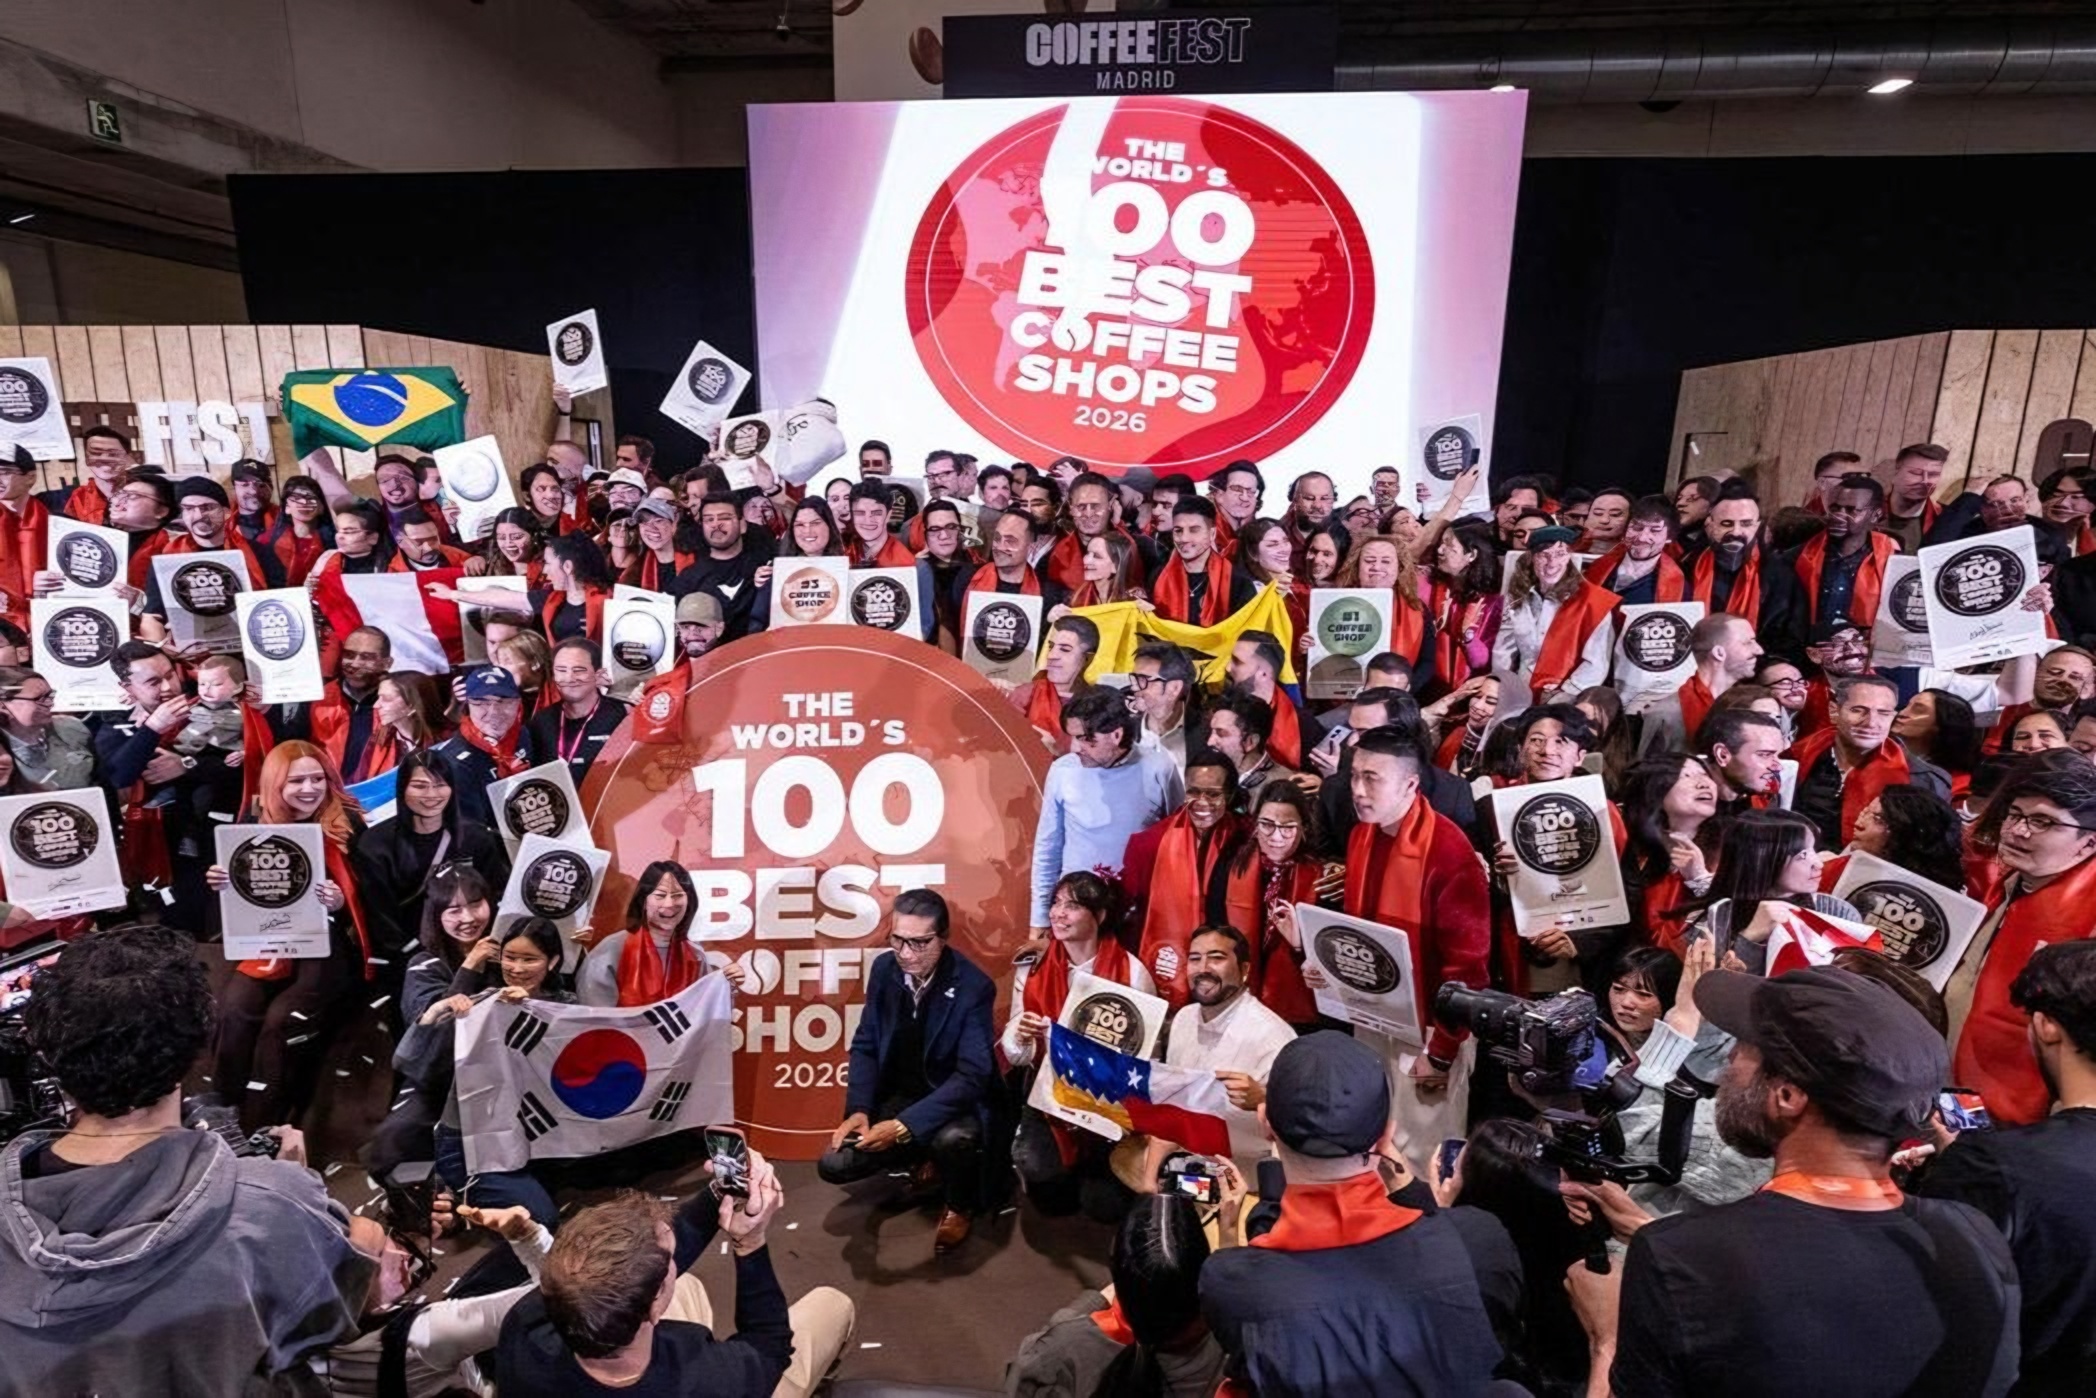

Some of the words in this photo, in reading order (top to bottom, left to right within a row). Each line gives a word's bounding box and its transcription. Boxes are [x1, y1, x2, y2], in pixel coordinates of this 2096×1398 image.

[1096, 70, 1175, 90] MADRID
[1124, 138, 1186, 162] THE
[1017, 251, 1252, 328] BEST
[1010, 311, 1240, 374] COFFEE
[1014, 354, 1217, 413] SHOPS
[1072, 405, 1147, 433] 2026
[138, 400, 272, 466] FEST
[1956, 559, 2002, 581] 100
[1641, 625, 1676, 640] 100
[783, 691, 853, 717] THE
[516, 792, 550, 813] 100
[693, 751, 945, 859] 100
[30, 815, 75, 834] 100
[1529, 810, 1575, 833] 100
[249, 853, 290, 869] 100
[543, 864, 578, 884] 100
[1871, 893, 1925, 932] 100
[1330, 938, 1375, 963] 100
[1091, 1005, 1128, 1033] 100
[1085, 1022, 1124, 1046] BEST
[774, 1063, 850, 1088] 2026
